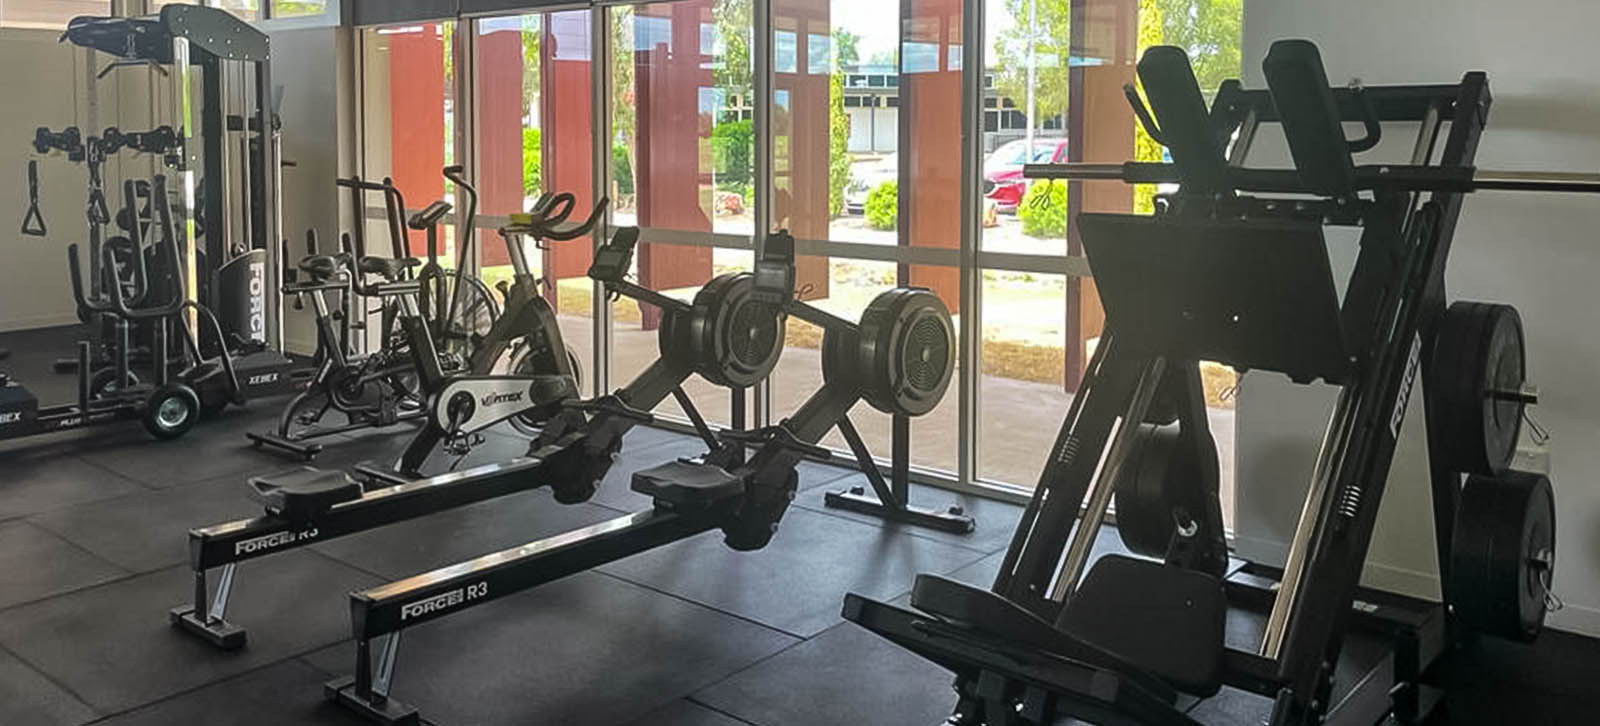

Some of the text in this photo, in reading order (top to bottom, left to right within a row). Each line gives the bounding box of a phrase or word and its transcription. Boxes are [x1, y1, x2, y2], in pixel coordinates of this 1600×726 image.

[235, 531, 292, 555] FORCE
[401, 582, 488, 620] FORCE R3
